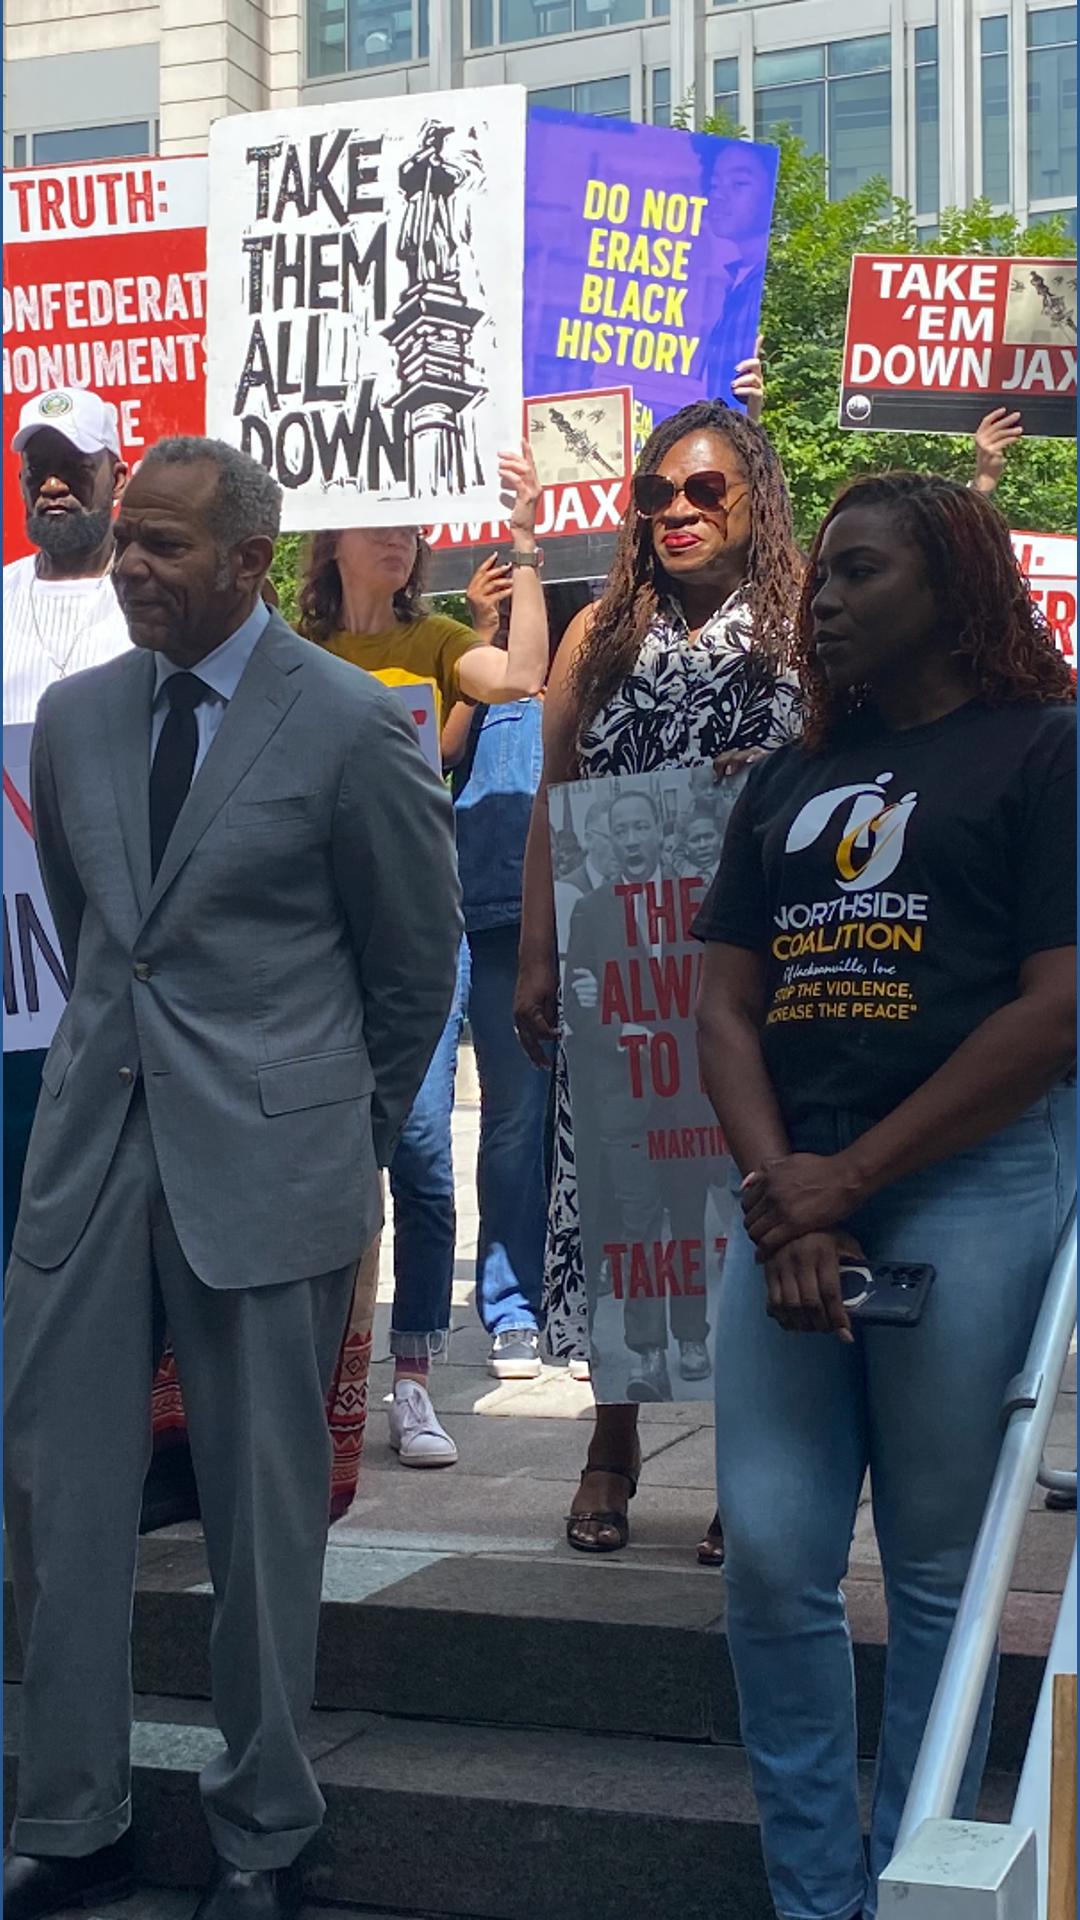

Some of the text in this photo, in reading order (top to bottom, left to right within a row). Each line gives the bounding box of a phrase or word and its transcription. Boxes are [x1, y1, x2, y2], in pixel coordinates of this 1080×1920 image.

[9, 170, 167, 232] TRUTH:
[247, 129, 384, 226] TAKE
[583, 180, 708, 236] DO NOT
[242, 221, 387, 321] THEM
[588, 228, 692, 281] ERASE
[872, 262, 997, 302] TAKE
[579, 273, 688, 328] BLACK
[233, 313, 349, 416] ALL
[556, 317, 700, 376] HISTORY
[850, 343, 992, 388] DOWN
[241, 378, 406, 491] DOWN
[533, 482, 624, 534] JAX
[773, 892, 928, 930] NORTHSIDE
[772, 922, 922, 961] COALITION
[602, 953, 703, 1025] ALW
[797, 982, 822, 998] THE
[826, 981, 913, 999] VIOLENCE,
[818, 1003, 847, 1018] THE
[852, 1003, 917, 1019] PEACE"
[619, 1031, 680, 1098] TO
[603, 1240, 706, 1299] TAKE
